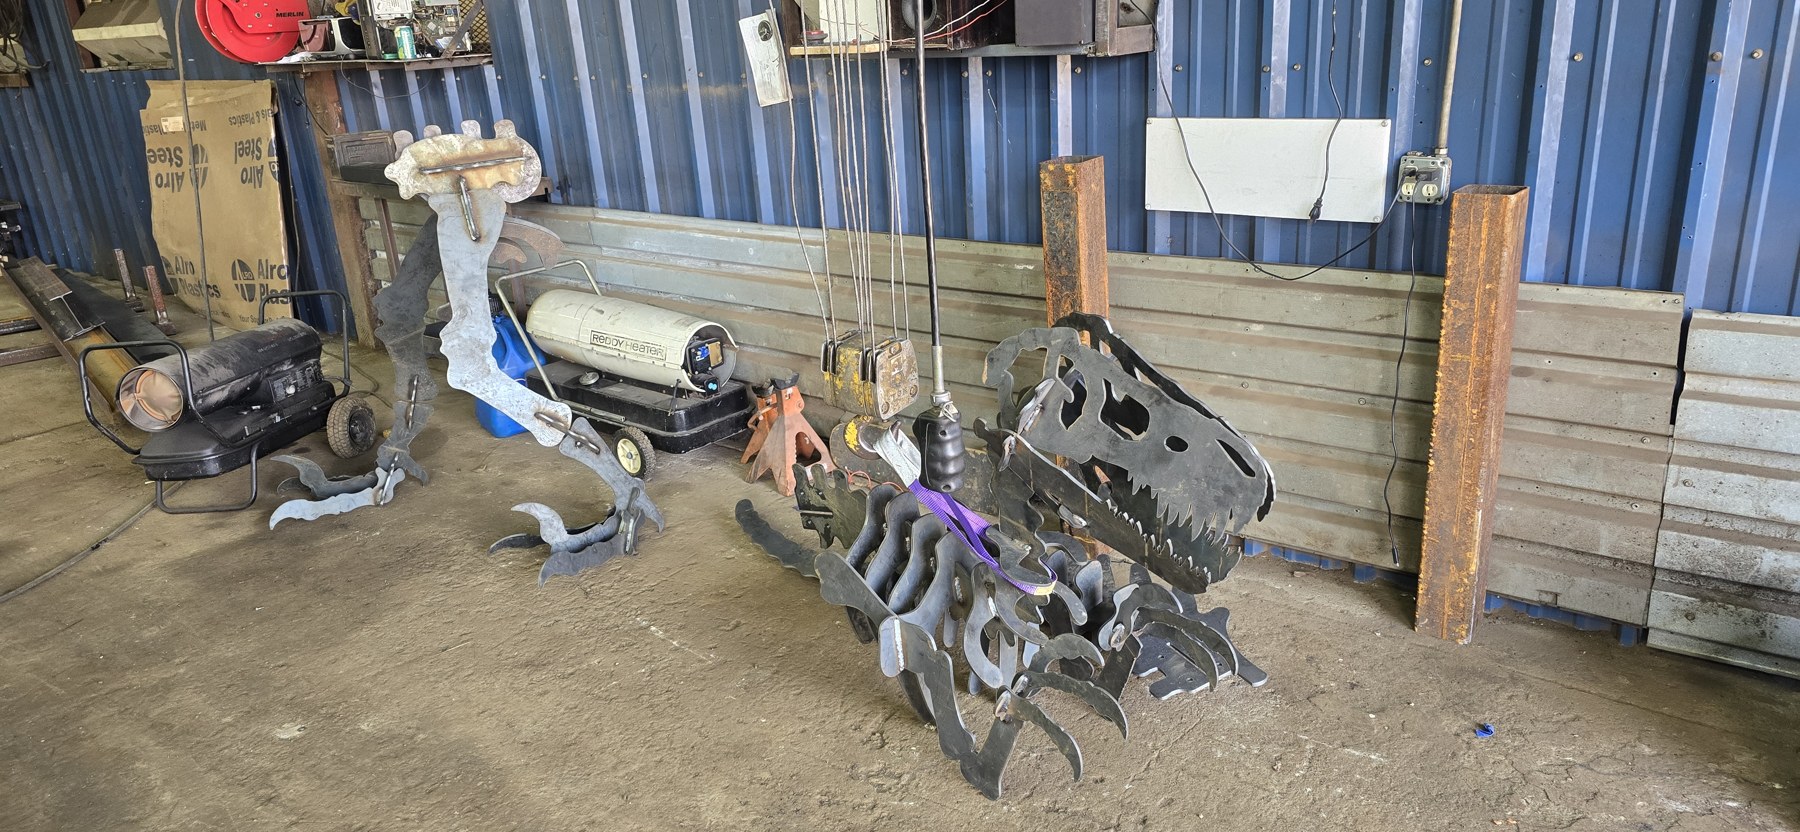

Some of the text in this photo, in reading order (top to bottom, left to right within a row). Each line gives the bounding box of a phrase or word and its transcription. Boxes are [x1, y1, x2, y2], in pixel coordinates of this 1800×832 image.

[234, 137, 262, 164] Steel
[155, 171, 185, 193] Alro
[240, 165, 264, 189] Alro
[175, 256, 195, 275] Alro
[257, 259, 290, 280] Alro
[179, 278, 221, 298] Plastcs
